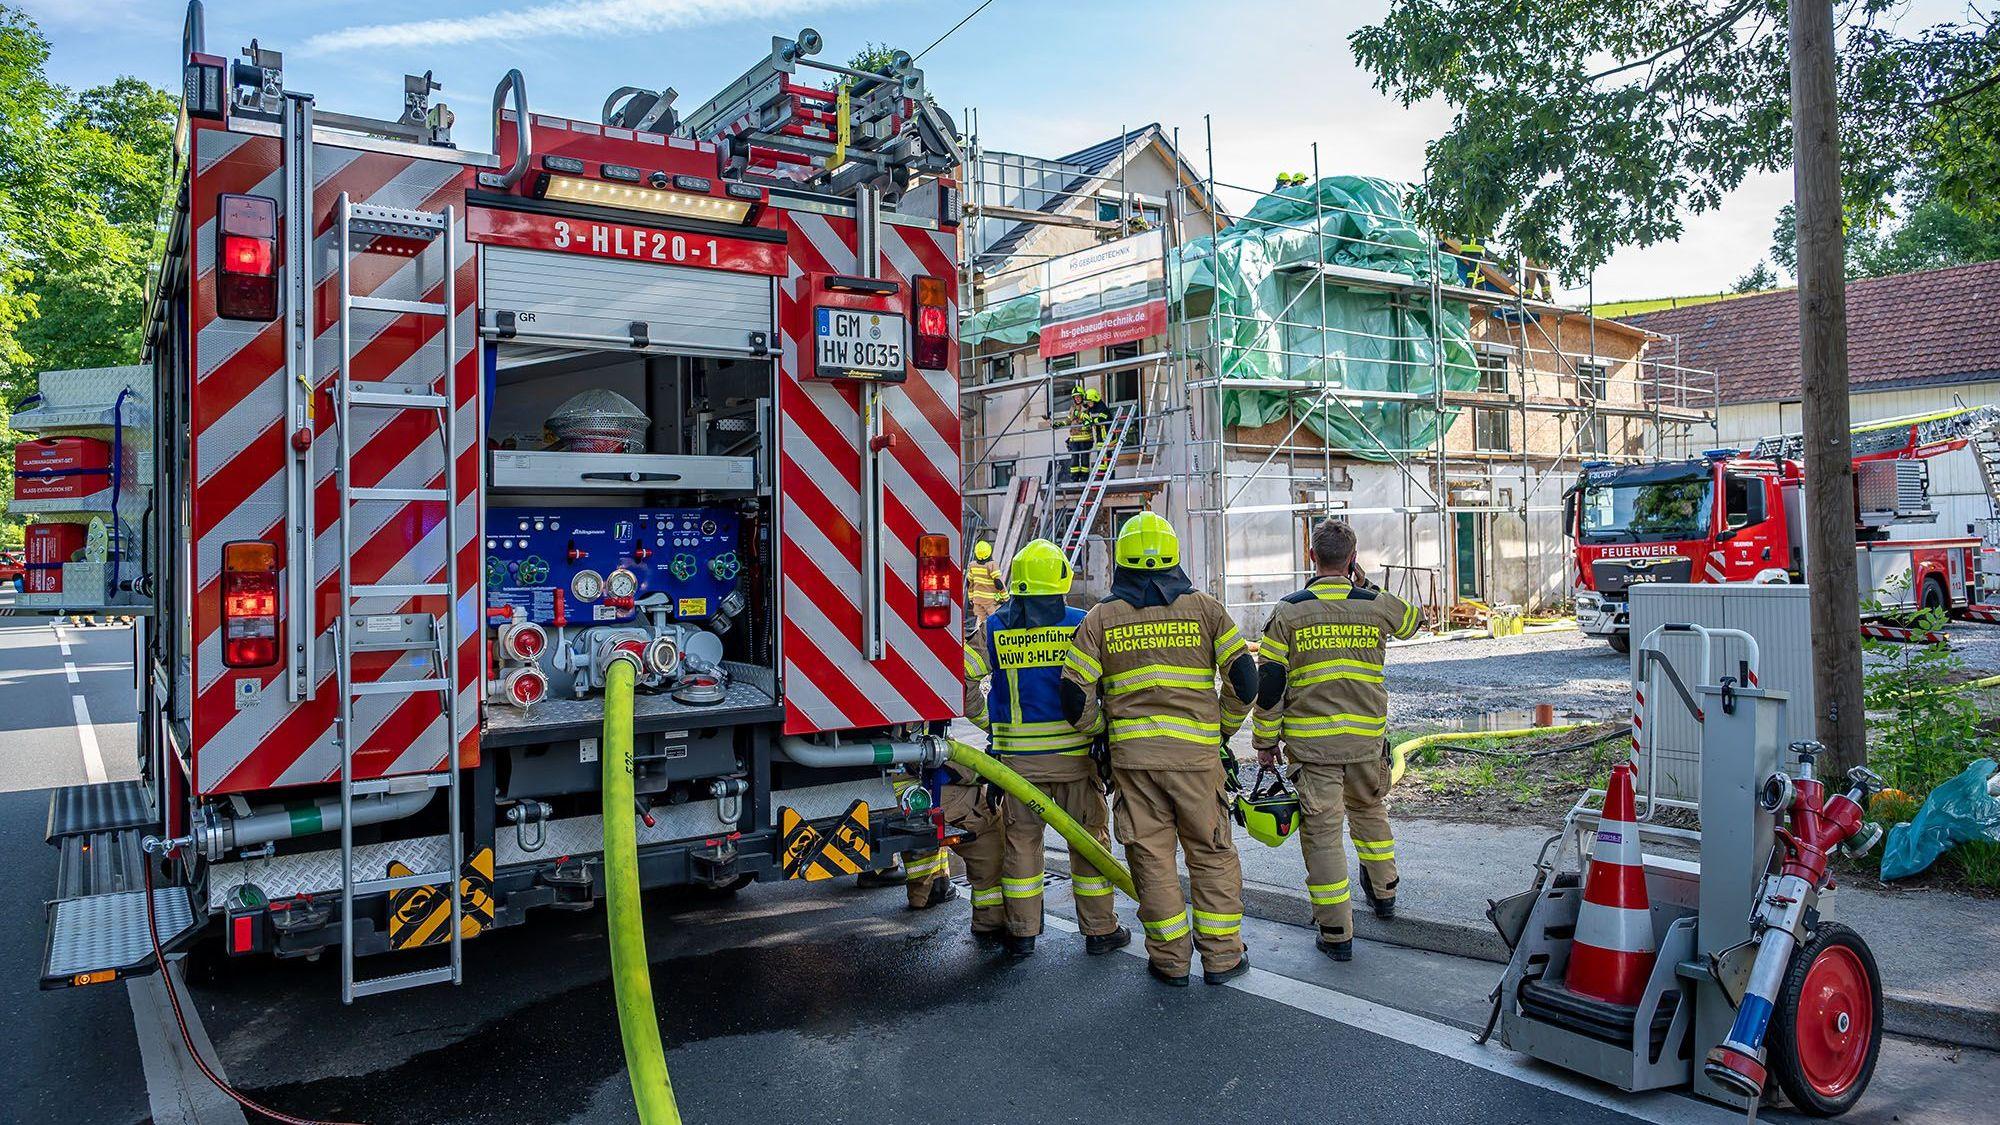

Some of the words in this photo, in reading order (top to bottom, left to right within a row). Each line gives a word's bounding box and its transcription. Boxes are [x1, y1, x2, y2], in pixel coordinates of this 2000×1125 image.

[554, 221, 718, 265] 3-HLF20-1
[519, 312, 536, 322] GR
[821, 325, 827, 333] D
[836, 314, 860, 338] GM
[823, 340, 848, 364] HW
[854, 342, 900, 368] 8035
[1601, 545, 1678, 557] FEUERWEHR
[1623, 574, 1656, 583] MAN
[998, 630, 1073, 647] Gruppenführ
[1104, 621, 1200, 641] FEUERWEHR
[1295, 624, 1380, 641] FEUERWEHR
[1106, 635, 1200, 654] HÜCKESWAGEN
[1296, 637, 1379, 652] HÜCKESWAGEN
[1000, 650, 1024, 665] HÜW
